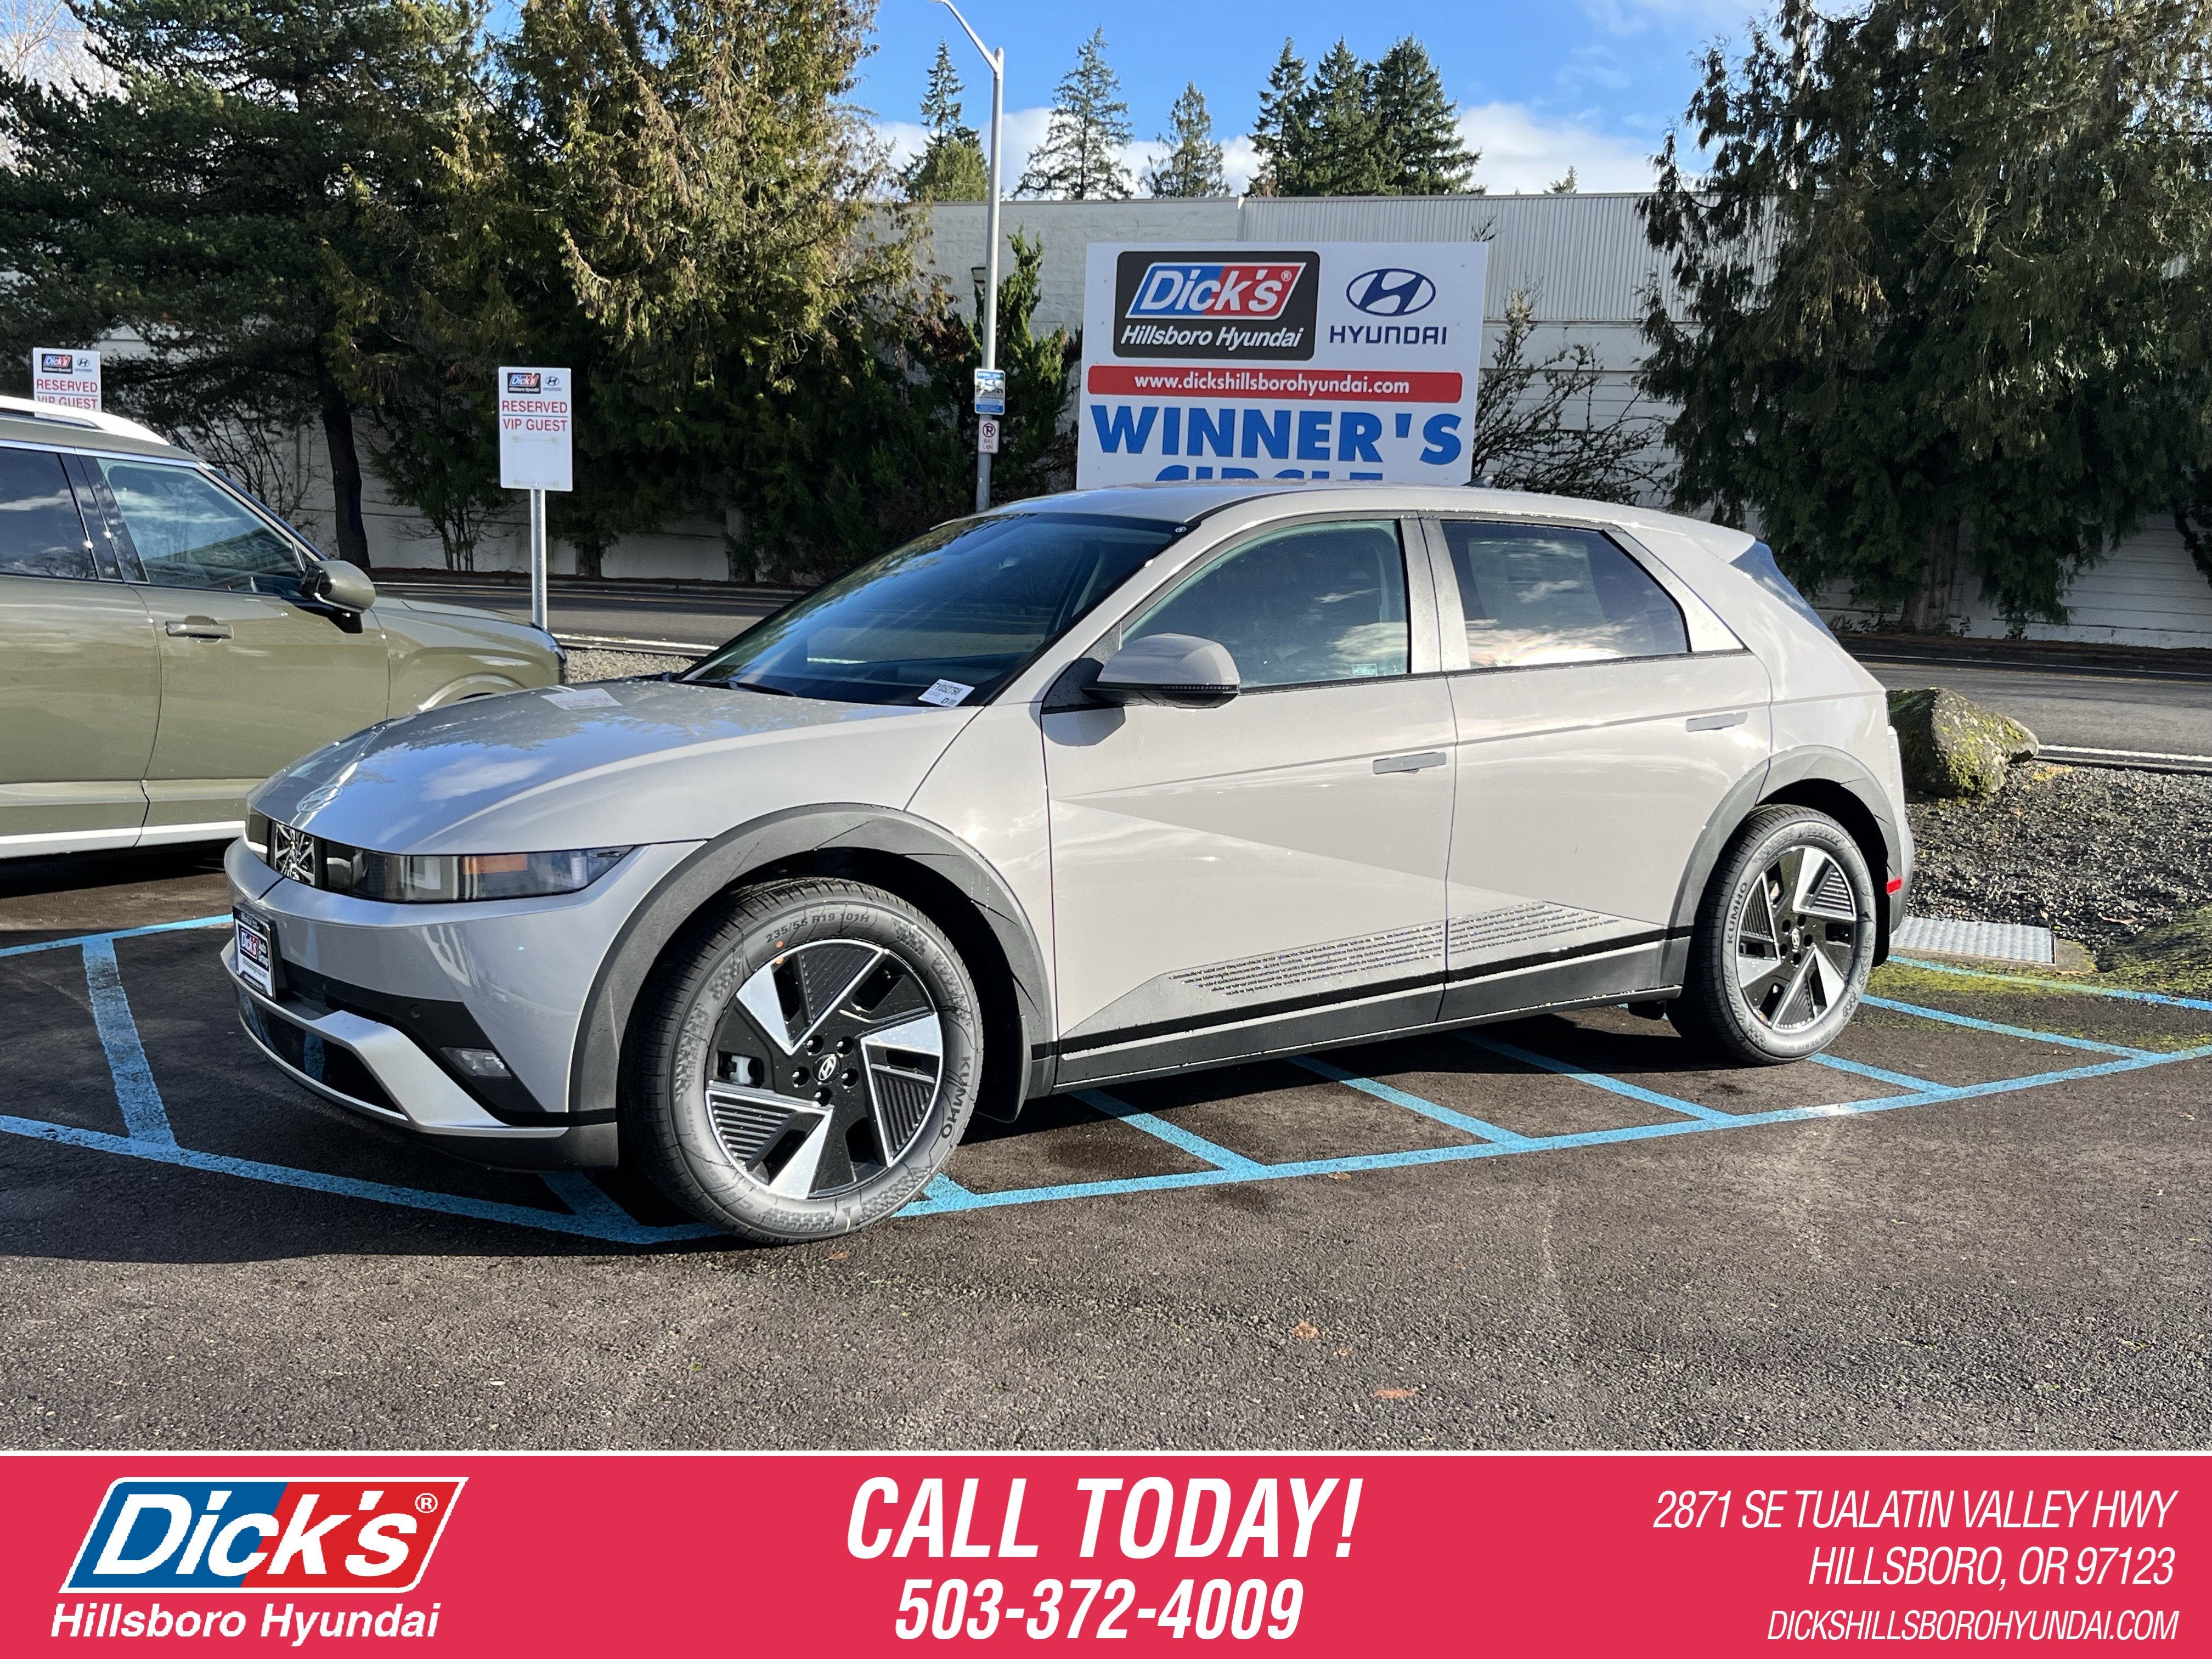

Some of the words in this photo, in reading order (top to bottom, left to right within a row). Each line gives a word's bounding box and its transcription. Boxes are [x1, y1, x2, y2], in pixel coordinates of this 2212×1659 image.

[1139, 269, 1282, 312] Dick's
[1120, 325, 1212, 346] Hillsboro
[1216, 328, 1304, 351] Hyundai
[1330, 326, 1447, 345] HYUNDAI
[36, 379, 98, 392] RESERVED
[1135, 371, 1409, 397] www.dickshillsborohyundai.com
[502, 400, 568, 413] RESERVED
[503, 418, 522, 430] VIP
[526, 418, 567, 431] GUEST
[1090, 404, 1462, 466] WINNER'S
[1727, 882, 1747, 944] KUMHO
[766, 917, 808, 943] 235/55
[812, 913, 836, 923] R19
[840, 912, 870, 923] 101H
[941, 1056, 970, 1138] KUMHO
